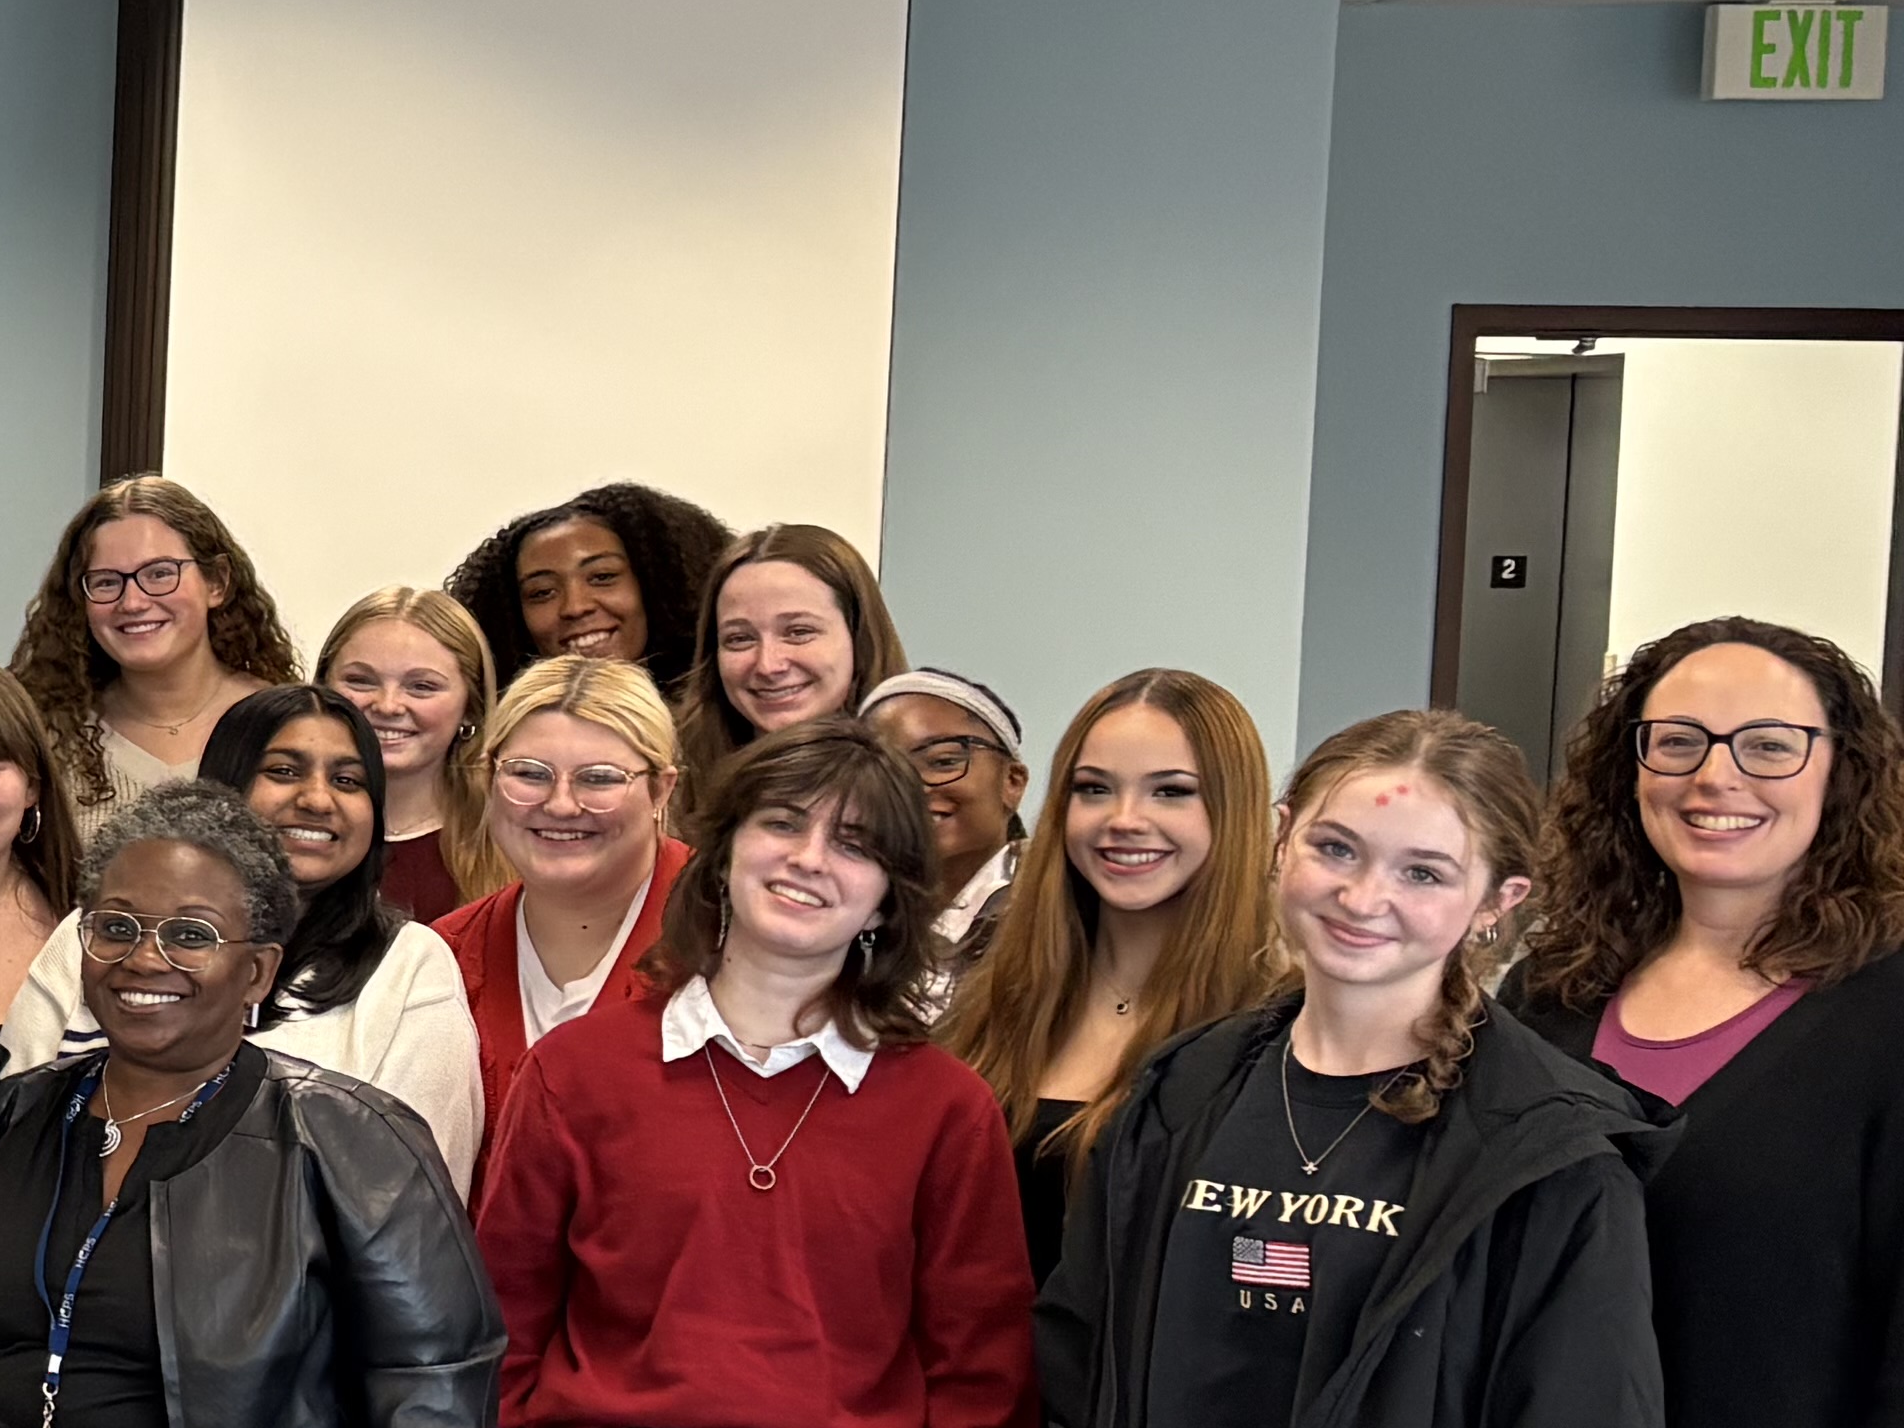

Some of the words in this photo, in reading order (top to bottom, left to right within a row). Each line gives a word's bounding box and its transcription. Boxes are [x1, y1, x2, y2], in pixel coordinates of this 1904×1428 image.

[1750, 9, 1864, 88] EXIT
[1501, 558, 1516, 579] 2
[1181, 1179, 1272, 1220] EW
[1276, 1192, 1405, 1237] YORK
[74, 1237, 97, 1268] HCPS
[58, 1293, 74, 1329] HCPS
